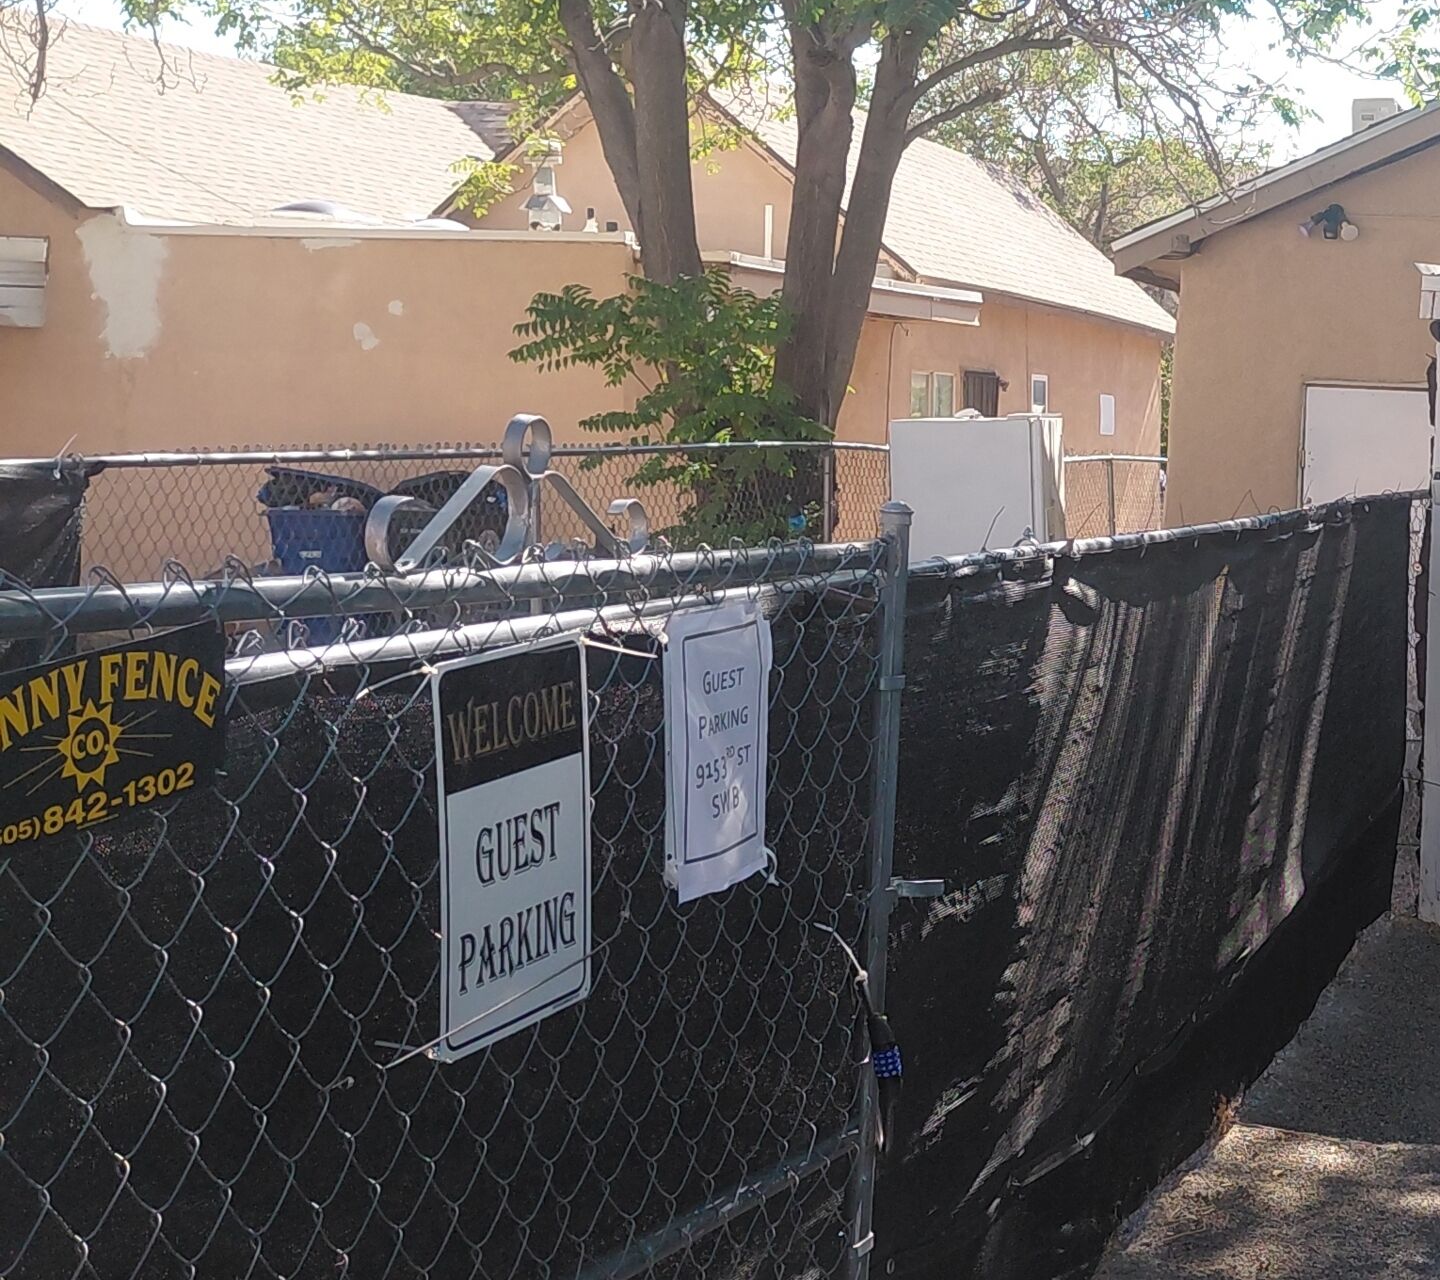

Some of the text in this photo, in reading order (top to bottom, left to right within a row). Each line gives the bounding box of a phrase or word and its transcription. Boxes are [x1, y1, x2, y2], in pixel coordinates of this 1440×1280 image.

[100, 651, 221, 728] FENCE
[702, 667, 745, 695] GUEST
[71, 729, 110, 760] CO.
[447, 681, 577, 763] WELCOME
[698, 705, 749, 740] PARKING
[737, 744, 752, 766] ST
[475, 801, 560, 886] GUEST
[458, 891, 576, 996] PARKING
